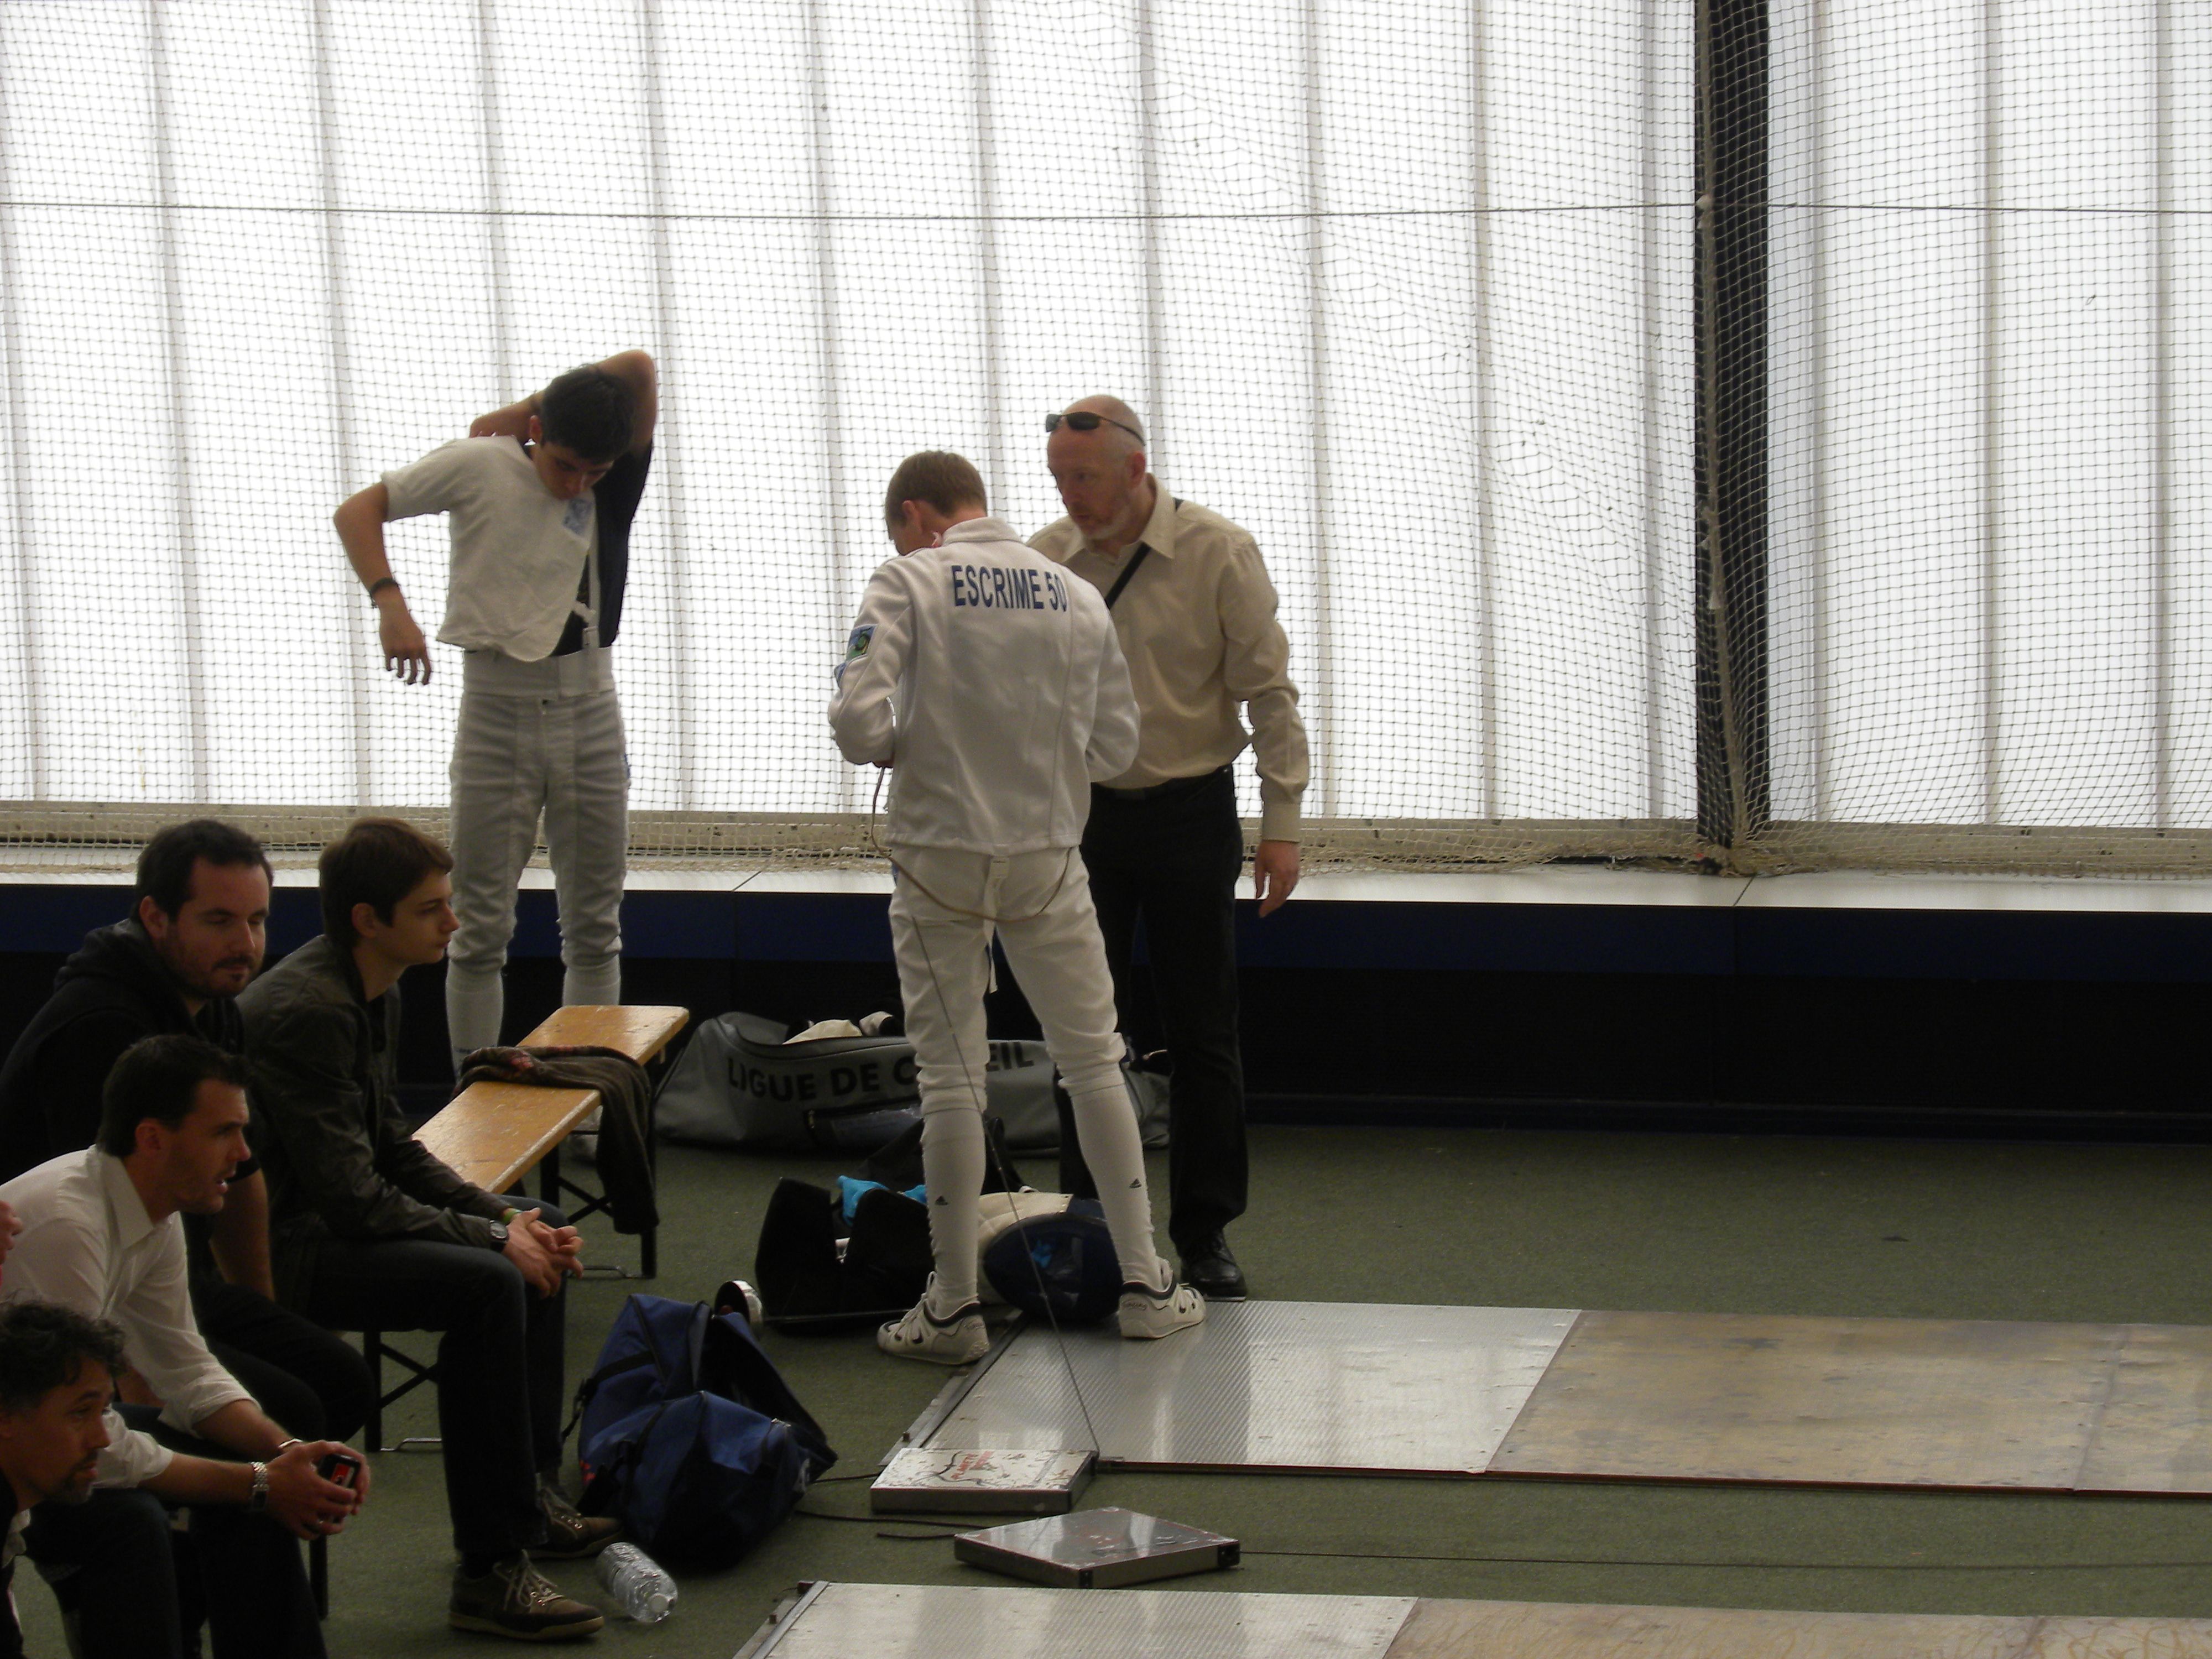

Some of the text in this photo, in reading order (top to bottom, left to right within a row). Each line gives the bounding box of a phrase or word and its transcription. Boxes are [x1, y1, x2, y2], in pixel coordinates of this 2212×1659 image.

[952, 564, 1068, 612] ESCRIME 50
[728, 1042, 1034, 1102] LIGUE DE CEIL
